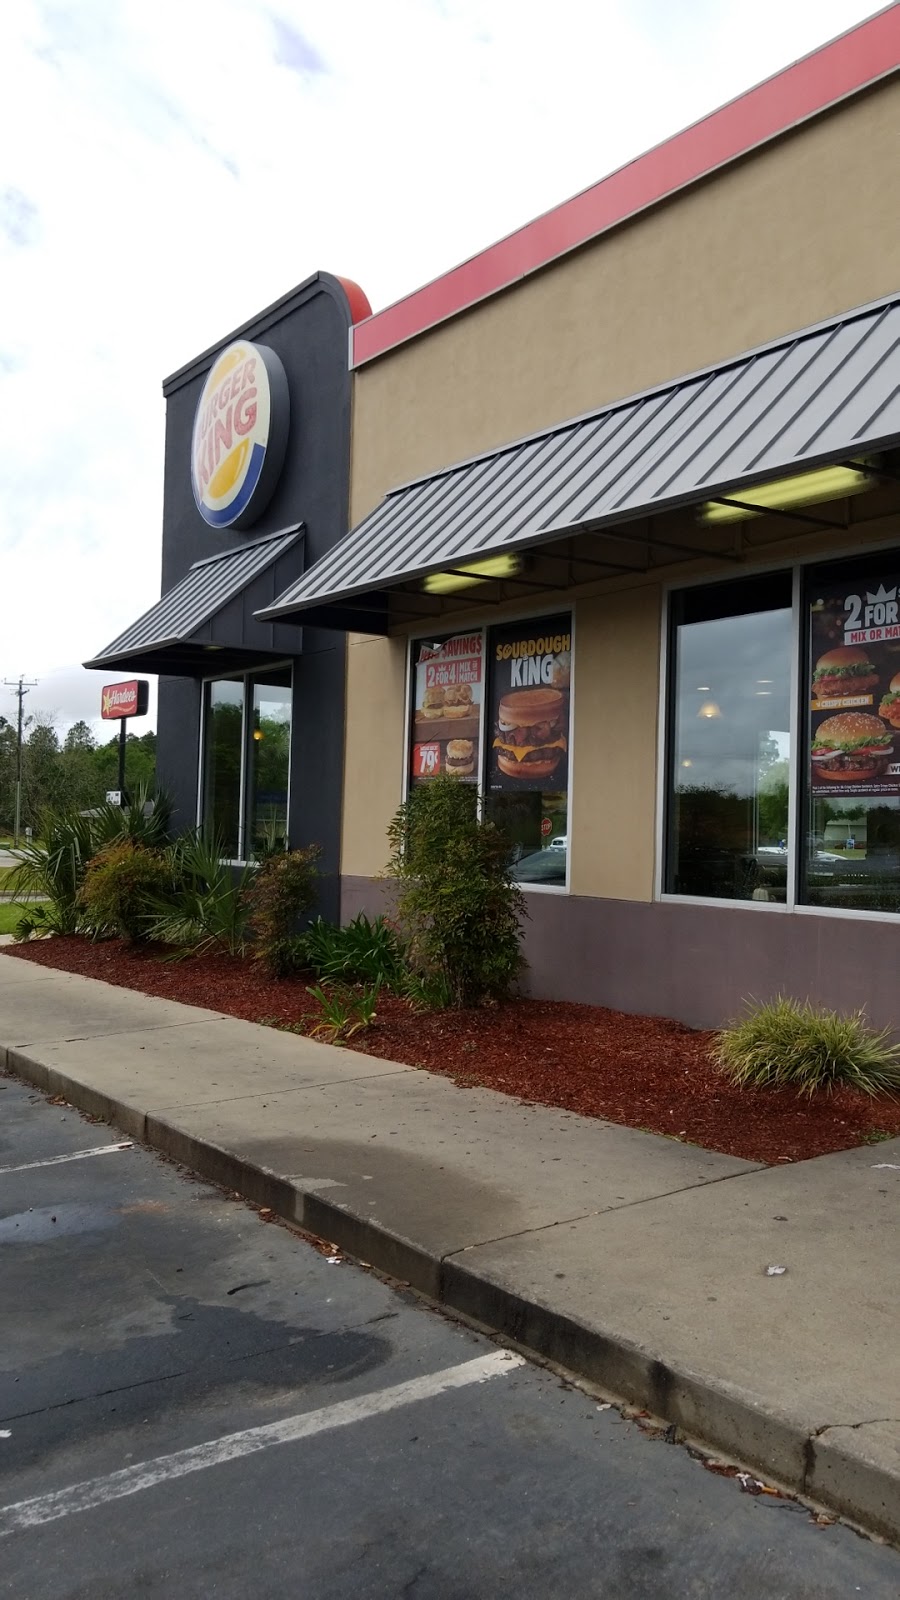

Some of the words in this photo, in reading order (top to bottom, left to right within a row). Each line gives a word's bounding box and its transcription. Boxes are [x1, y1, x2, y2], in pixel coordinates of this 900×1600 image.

[844, 594, 862, 631] 2
[865, 600, 899, 628] FOR
[851, 631, 867, 643] MIX
[870, 628, 882, 640] OR
[496, 634, 571, 661] SOURDOUGH
[459, 661, 471, 673] MIX
[428, 666, 435, 688] 2
[435, 671, 449, 685] FOR
[459, 671, 478, 683] MATCH
